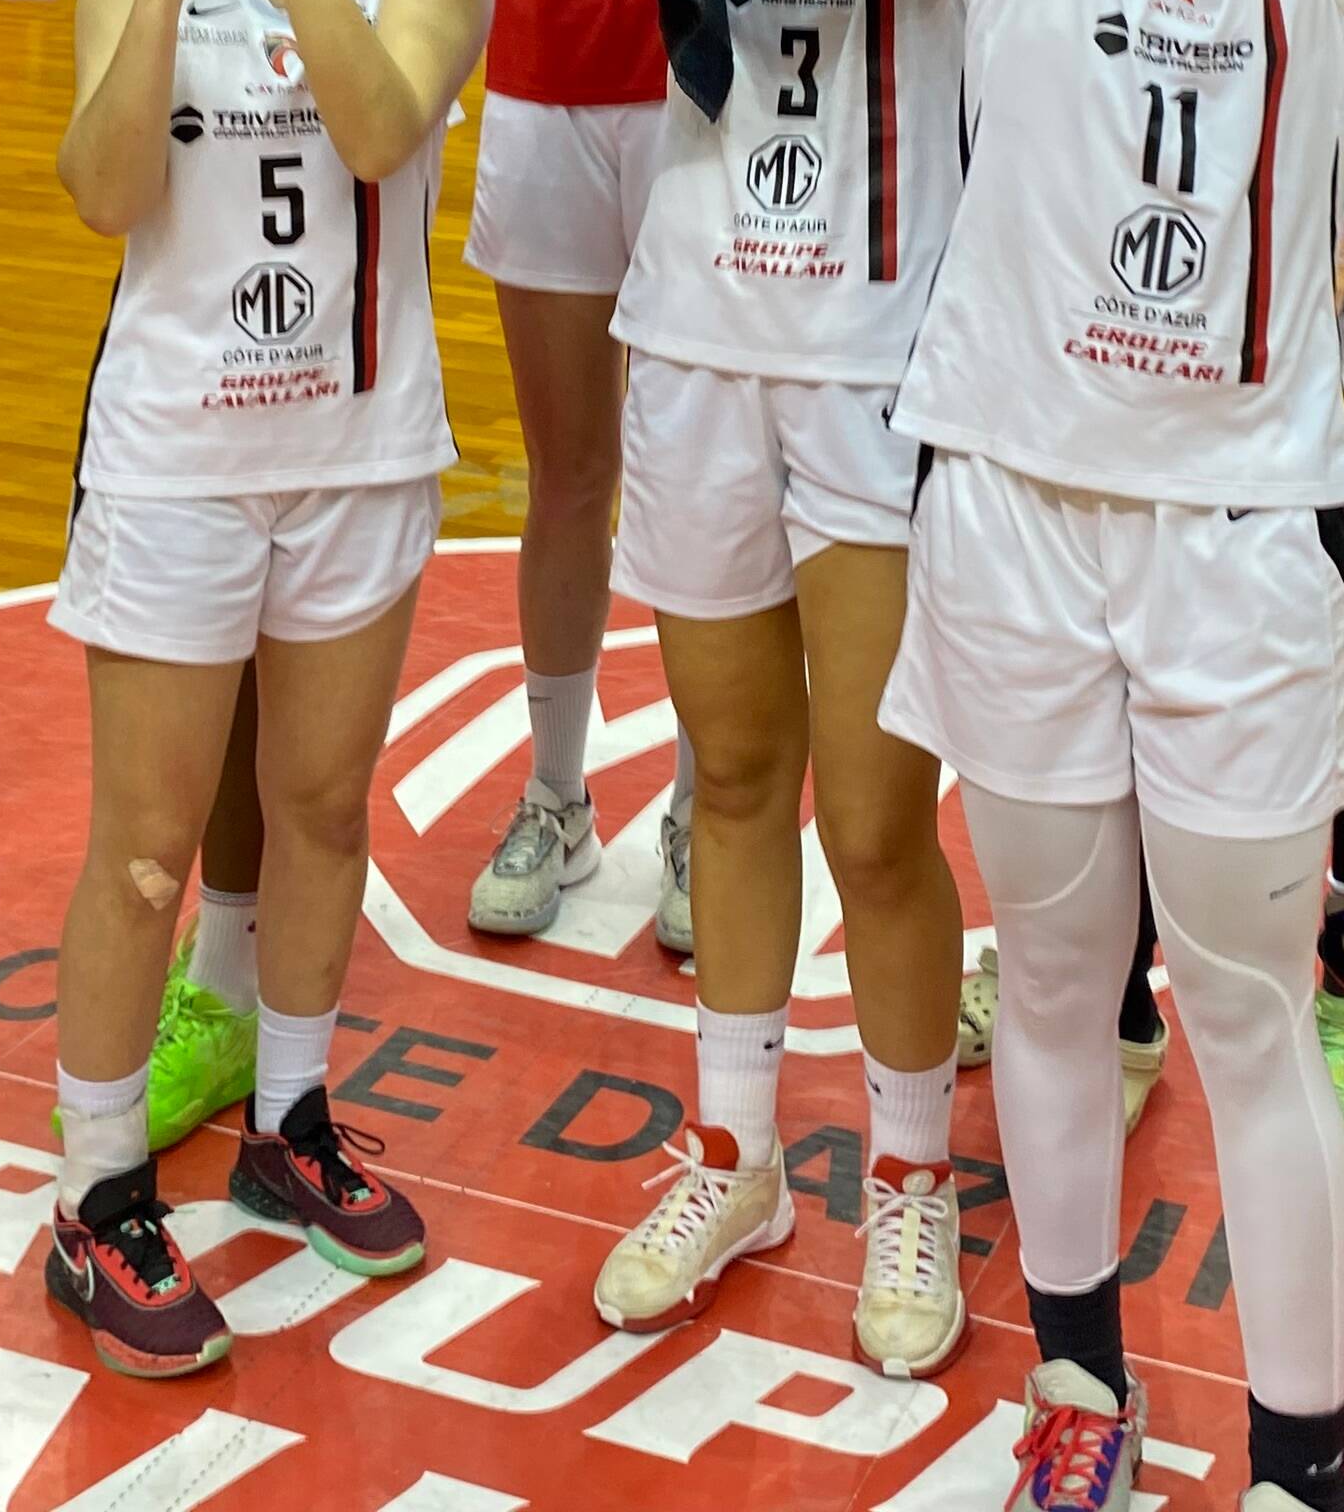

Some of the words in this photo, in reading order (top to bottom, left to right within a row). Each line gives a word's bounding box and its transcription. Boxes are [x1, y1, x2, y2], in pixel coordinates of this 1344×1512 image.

[1138, 27, 1254, 59] TRIVERIO
[777, 25, 821, 118] 3
[1141, 81, 1199, 194] 11
[754, 138, 816, 206] MG
[258, 152, 306, 247] 5
[733, 212, 771, 231] CÔTE
[713, 252, 847, 278] CAVALLARI
[732, 237, 829, 259] GROUPE
[1119, 216, 1198, 291] MG
[238, 270, 308, 337] MG
[1094, 294, 1141, 322] CÔTE
[1144, 307, 1208, 330] D'AZUR
[222, 345, 265, 366] CÔTE
[1085, 322, 1208, 357] GROUPE
[1063, 338, 1224, 384] CAVALLARI
